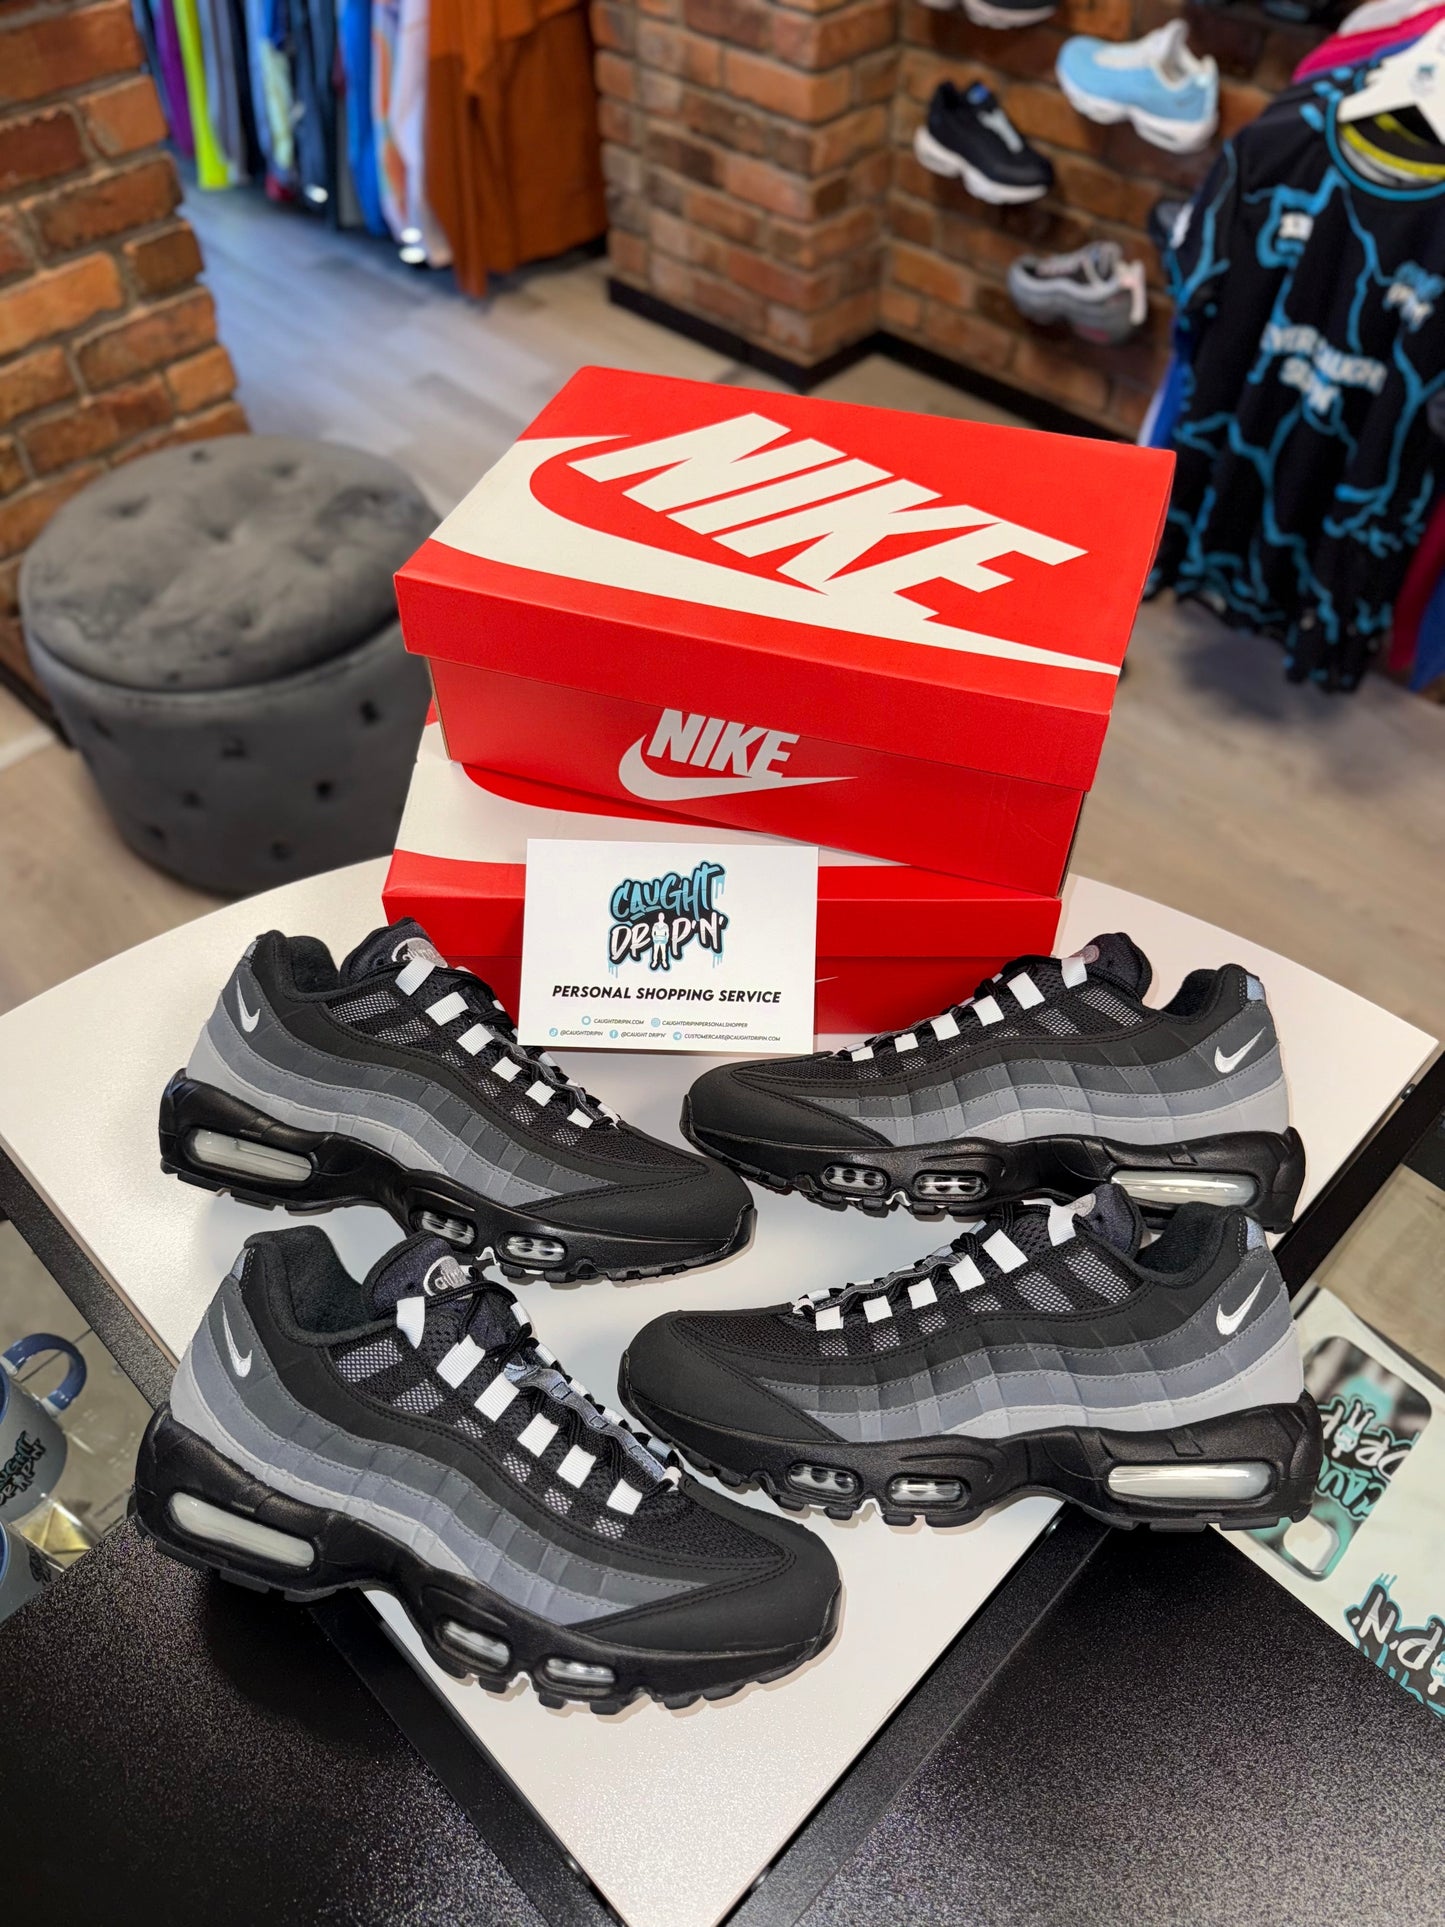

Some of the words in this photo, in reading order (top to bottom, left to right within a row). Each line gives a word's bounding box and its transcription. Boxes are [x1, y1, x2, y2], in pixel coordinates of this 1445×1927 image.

[566, 412, 1089, 622] NIKE
[646, 709, 800, 779] NIKE
[611, 861, 724, 921] CAUGHT
[552, 985, 632, 999] PERSONAL
[636, 987, 715, 1002] SHOPPING
[718, 990, 782, 1004] SERVICE
